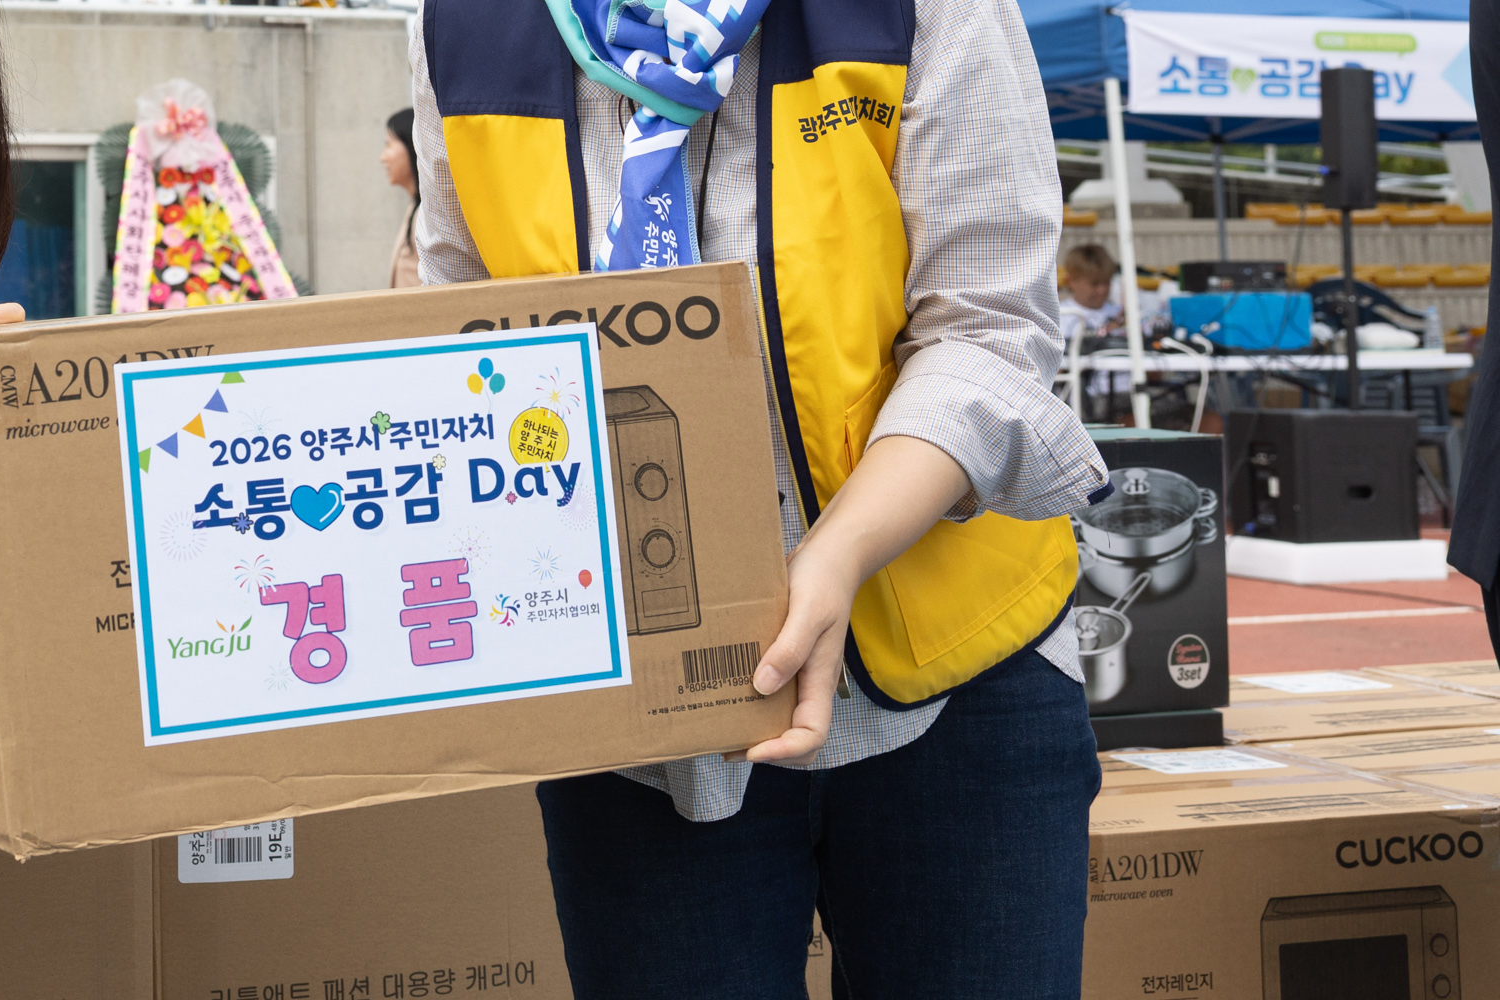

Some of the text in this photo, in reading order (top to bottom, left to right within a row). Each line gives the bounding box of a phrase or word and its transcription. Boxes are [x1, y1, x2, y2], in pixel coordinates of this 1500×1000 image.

[1158, 55, 1230, 98] 소통
[0, 364, 20, 410] CMW
[4, 415, 110, 441] microwave
[208, 412, 494, 467] 2026 양주시 주민자치
[523, 419, 559, 440] 하나되는
[517, 441, 554, 462] 주민자치
[192, 457, 582, 541] 소통 공감 Day
[524, 587, 569, 608] 양주시
[526, 602, 601, 623] 주민자치협의회
[1176, 666, 1202, 682] 3set
[268, 833, 282, 862] 19E
[1335, 830, 1484, 869] CUCKOO
[1089, 857, 1098, 884] CMW
[1101, 849, 1205, 883] A201DW
[1090, 888, 1174, 903] microwave oven
[383, 967, 456, 999] 대용량
[465, 960, 535, 991] 캐리어
[1141, 971, 1214, 995] 전자레인지
